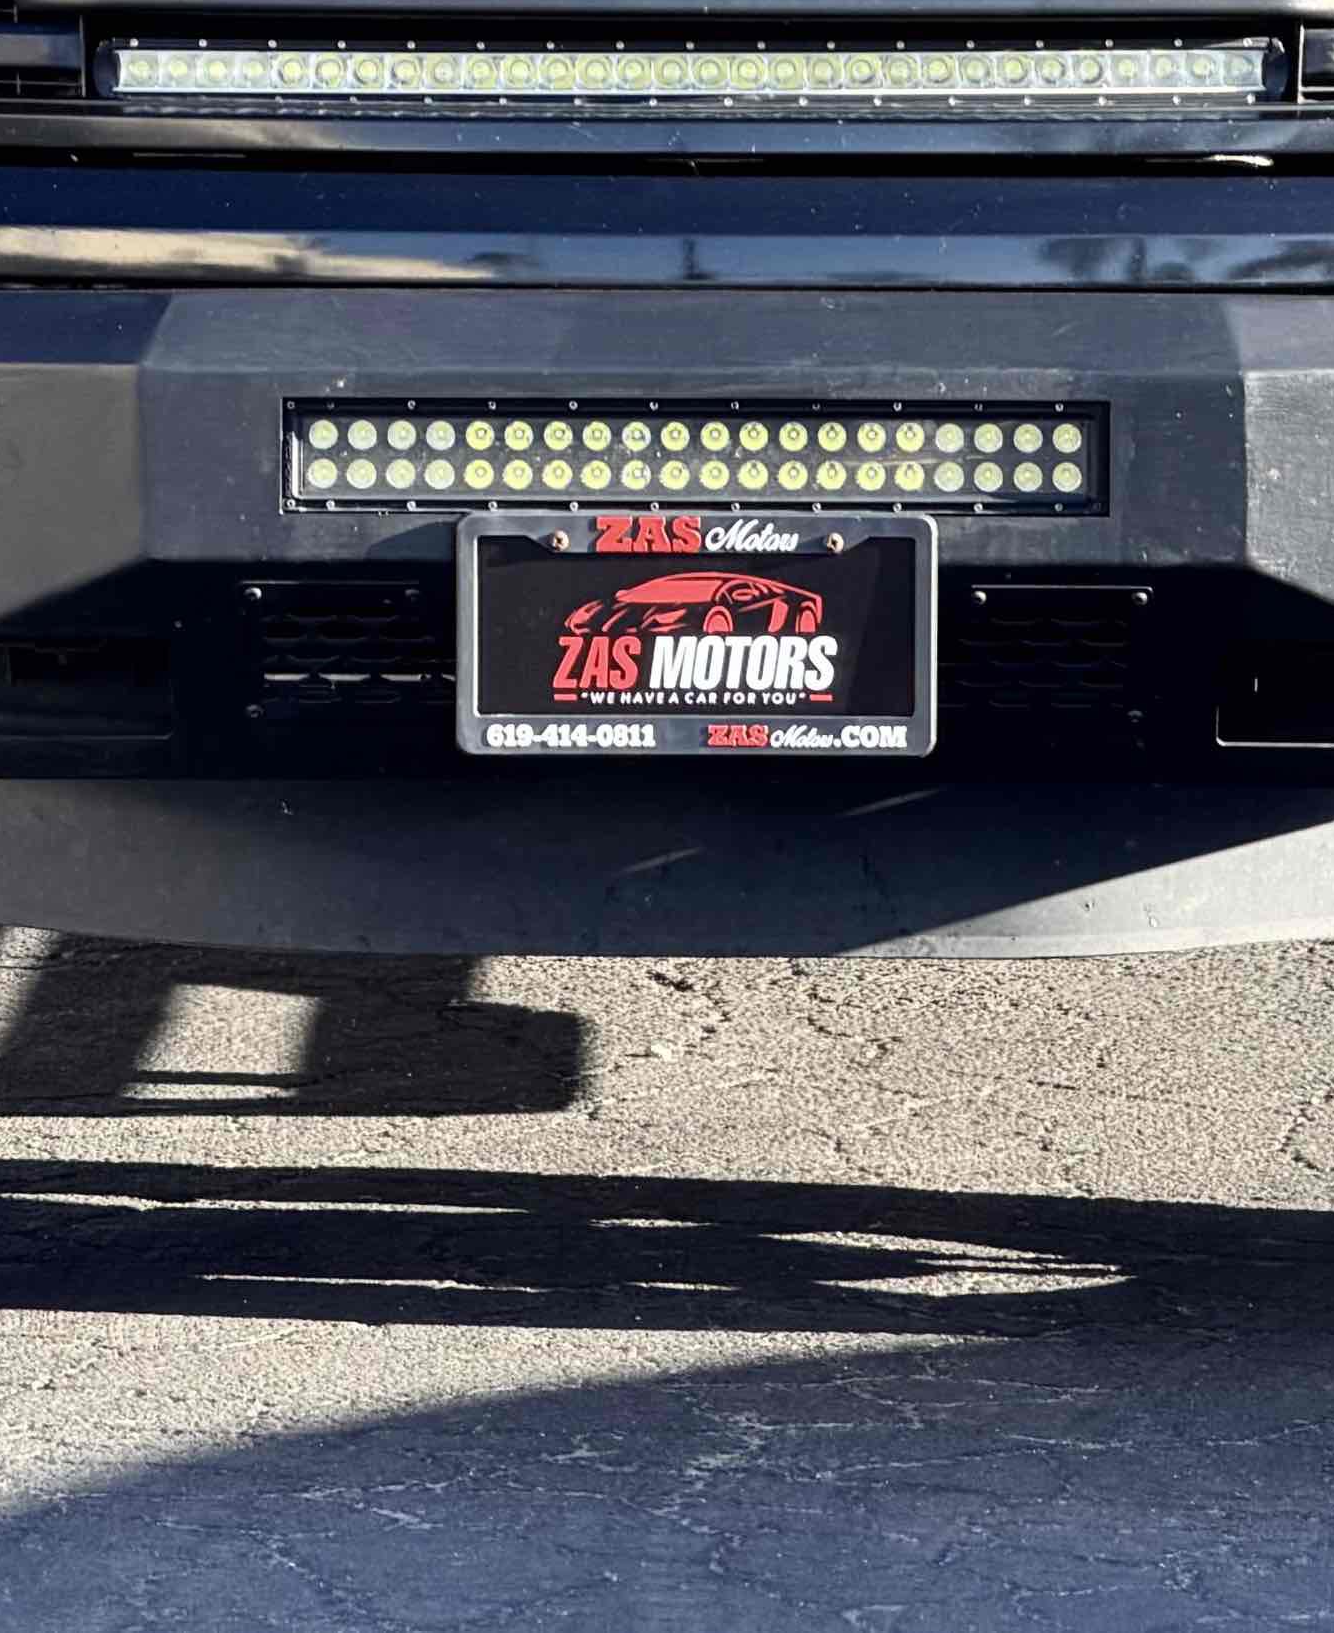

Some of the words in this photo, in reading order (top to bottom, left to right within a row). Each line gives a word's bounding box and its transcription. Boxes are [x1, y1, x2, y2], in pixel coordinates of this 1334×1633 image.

[596, 515, 702, 553] ZAS
[704, 518, 800, 552] Motors
[553, 635, 642, 689] ZAS
[649, 635, 838, 691] MOTORS
[620, 691, 665, 705] HAVE
[668, 691, 679, 705] A
[684, 691, 717, 705] CAR
[723, 691, 756, 705] FOR
[486, 723, 657, 747] 619-414-0811
